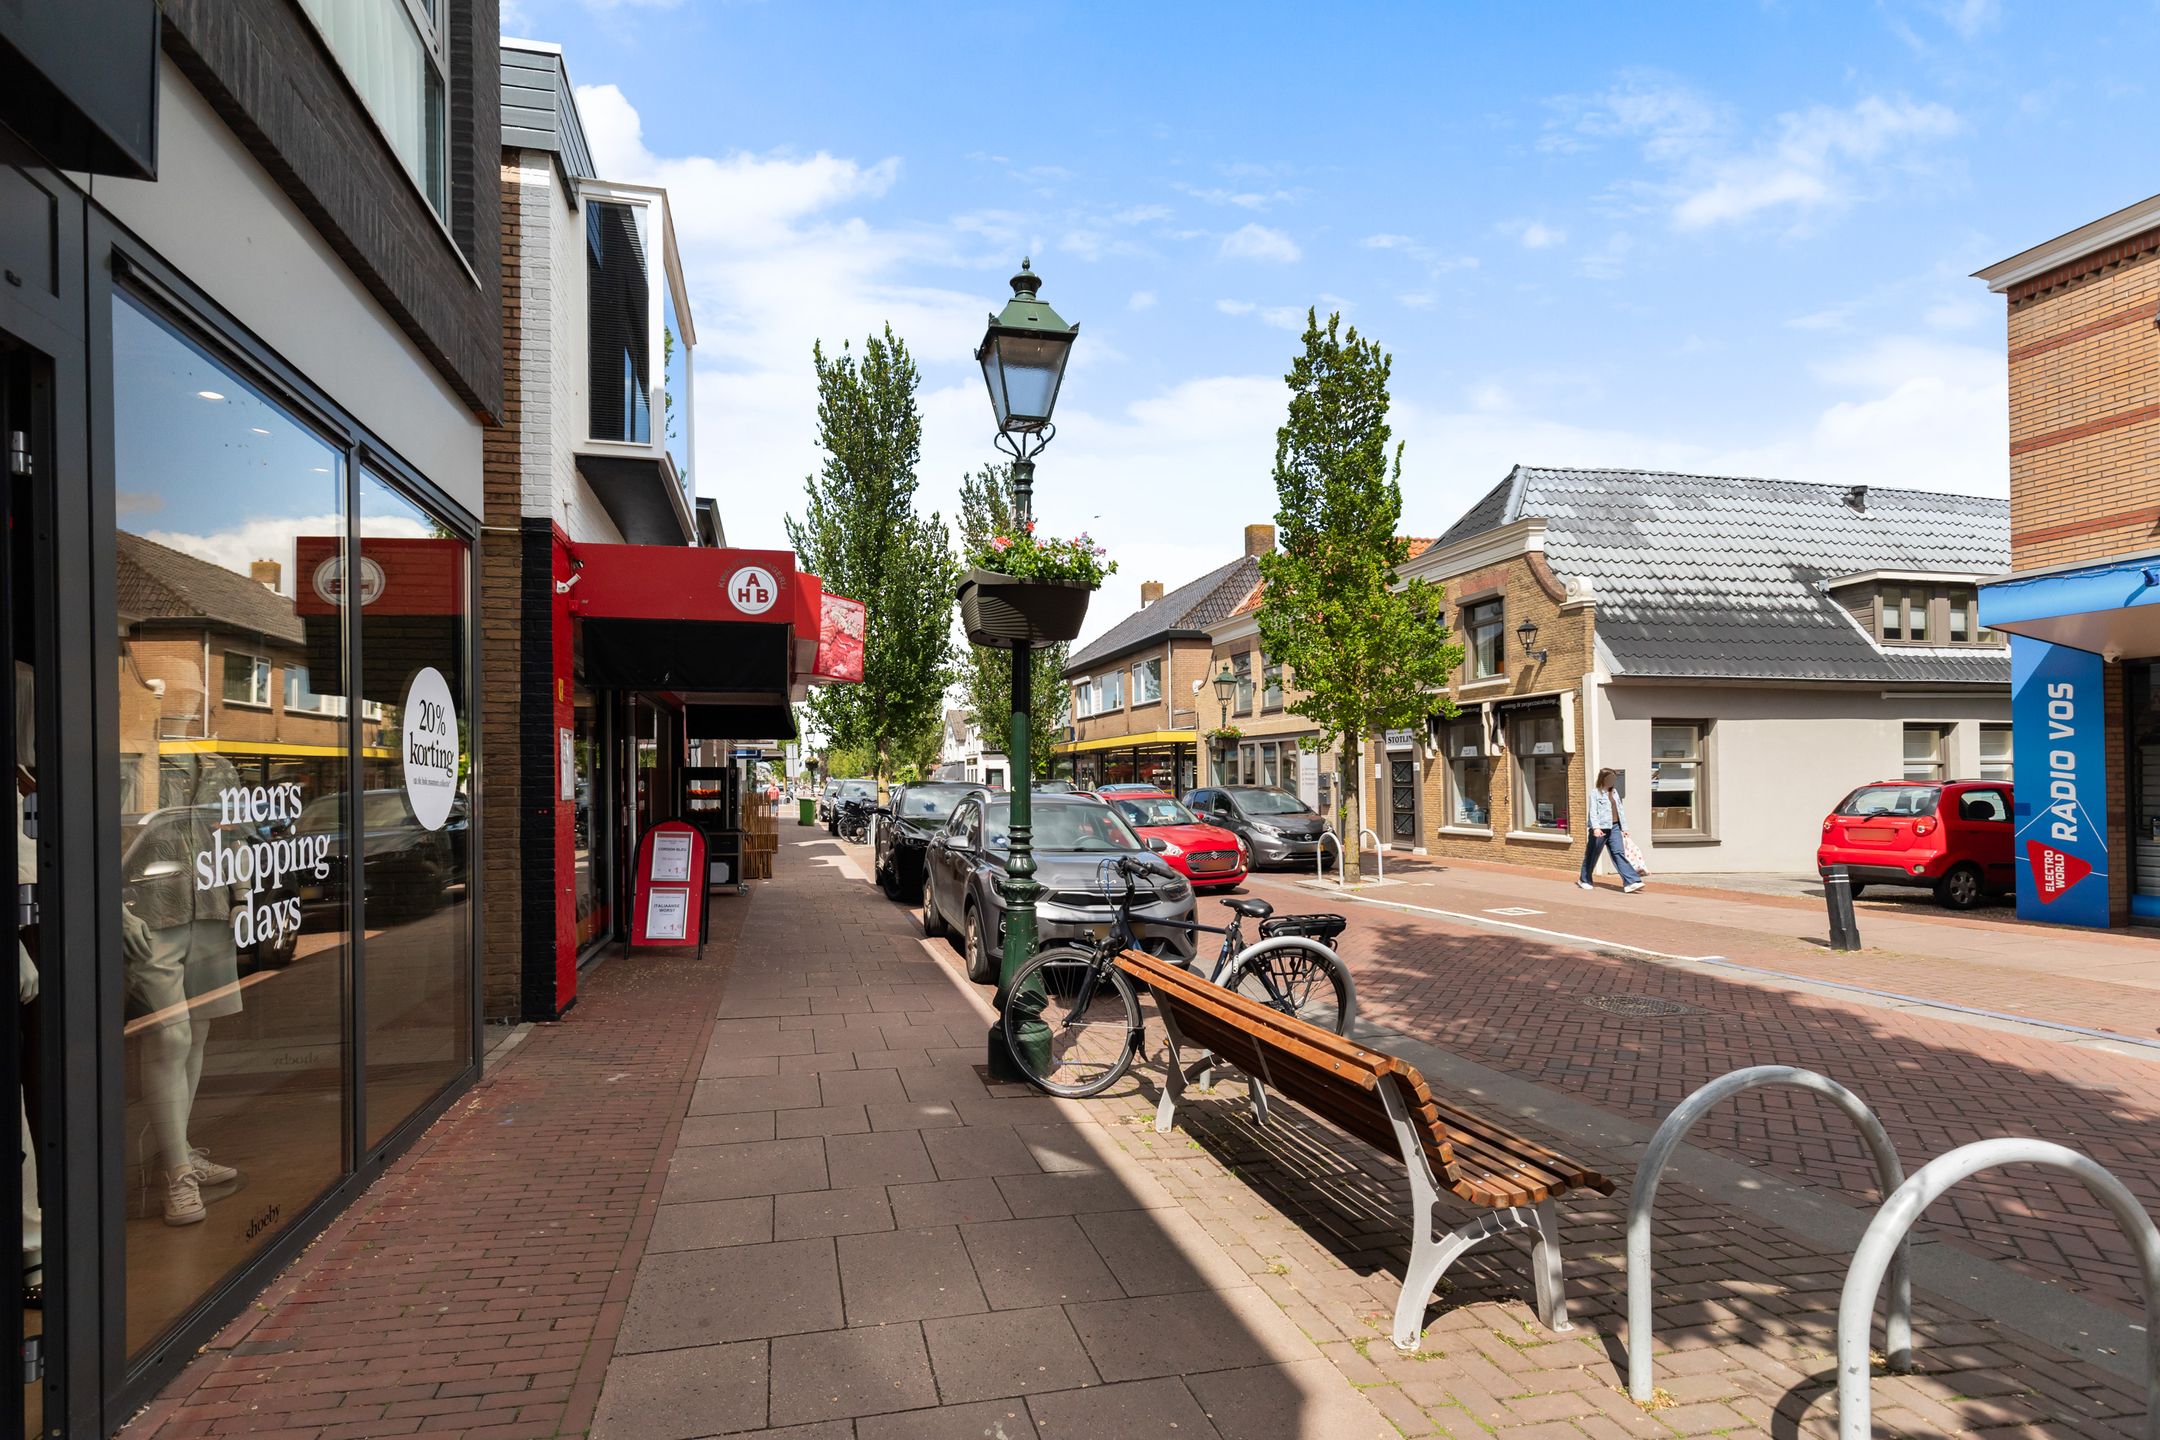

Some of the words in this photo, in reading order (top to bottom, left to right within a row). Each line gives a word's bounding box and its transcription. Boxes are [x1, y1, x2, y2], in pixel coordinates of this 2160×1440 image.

[419, 699, 446, 736] 20%
[2047, 682, 2075, 740] VOS
[409, 731, 454, 779] korting
[218, 783, 303, 825] men's
[2049, 750, 2078, 842] RADIO
[196, 825, 331, 894] shopping
[2044, 850, 2055, 892] ELECTRO
[2055, 853, 2065, 888] WORLD
[234, 889, 302, 950] days
[246, 1204, 281, 1243] shoeby
